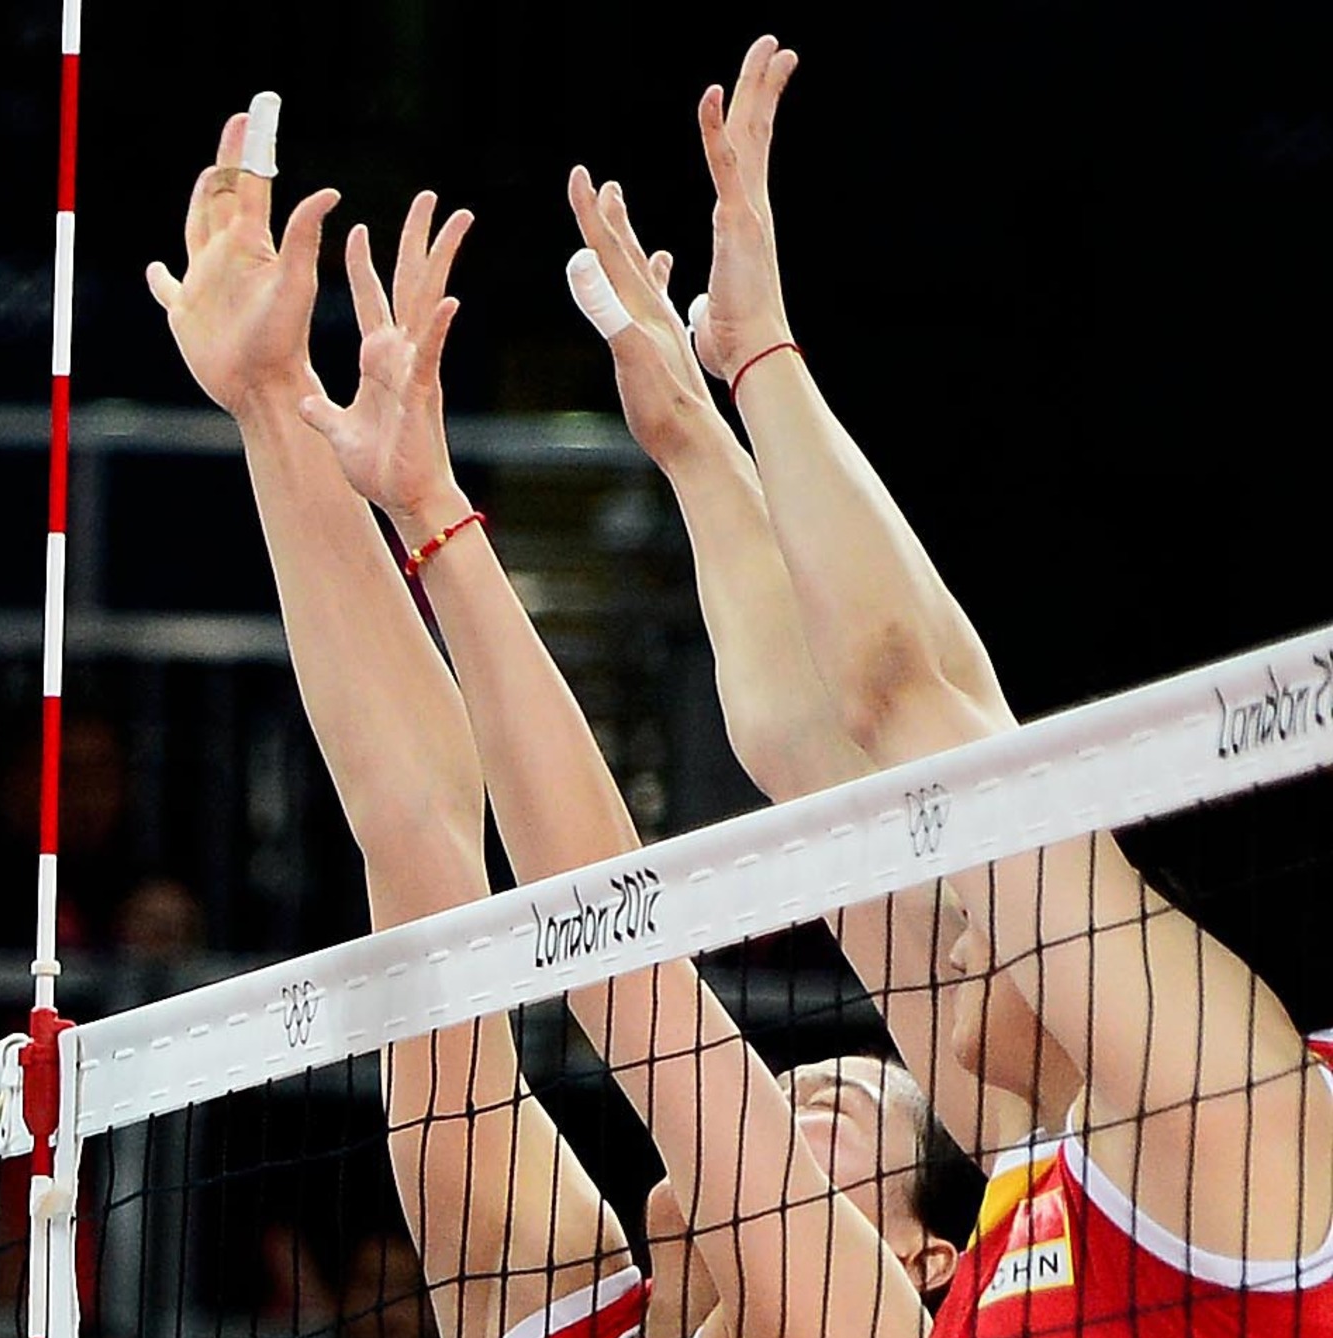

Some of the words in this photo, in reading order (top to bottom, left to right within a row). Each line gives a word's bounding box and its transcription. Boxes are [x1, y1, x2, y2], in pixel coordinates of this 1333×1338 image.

[1215, 665, 1309, 758] London
[531, 885, 608, 968] London
[609, 867, 665, 943] 2012
